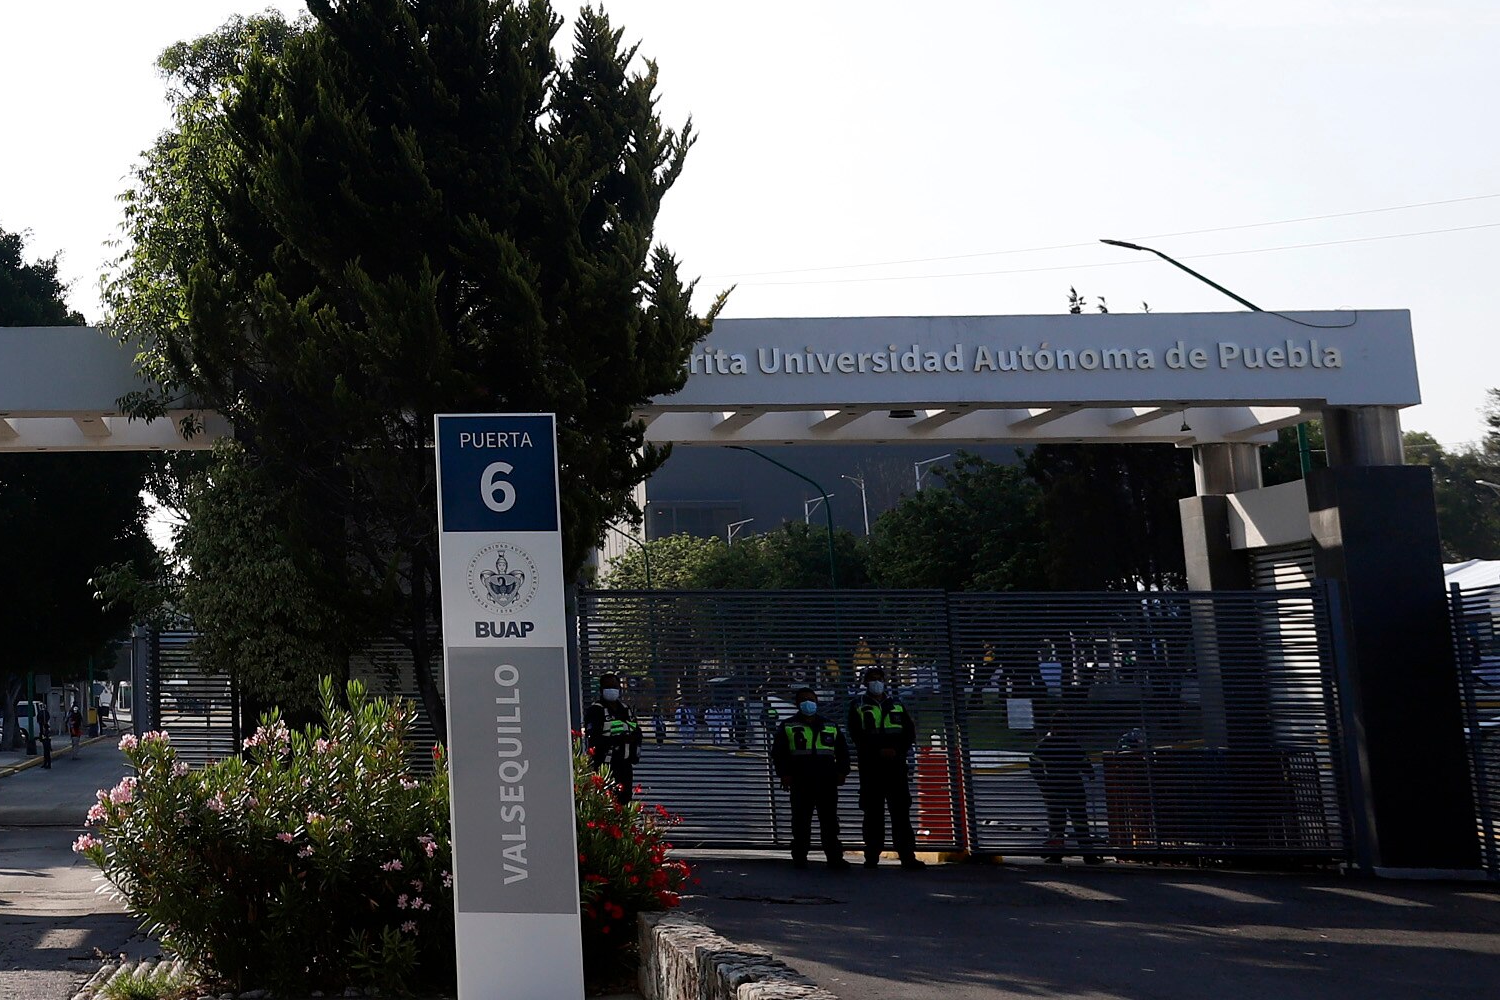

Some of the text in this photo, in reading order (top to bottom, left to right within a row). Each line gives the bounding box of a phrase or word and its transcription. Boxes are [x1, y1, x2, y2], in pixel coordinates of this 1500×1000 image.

[688, 338, 1342, 375] rita Universidad Autónoma de Puebla
[460, 432, 533, 448] PUERTA
[480, 461, 516, 513] 6
[475, 621, 535, 638] BUAP
[494, 664, 529, 885] VALSEQUILLO
